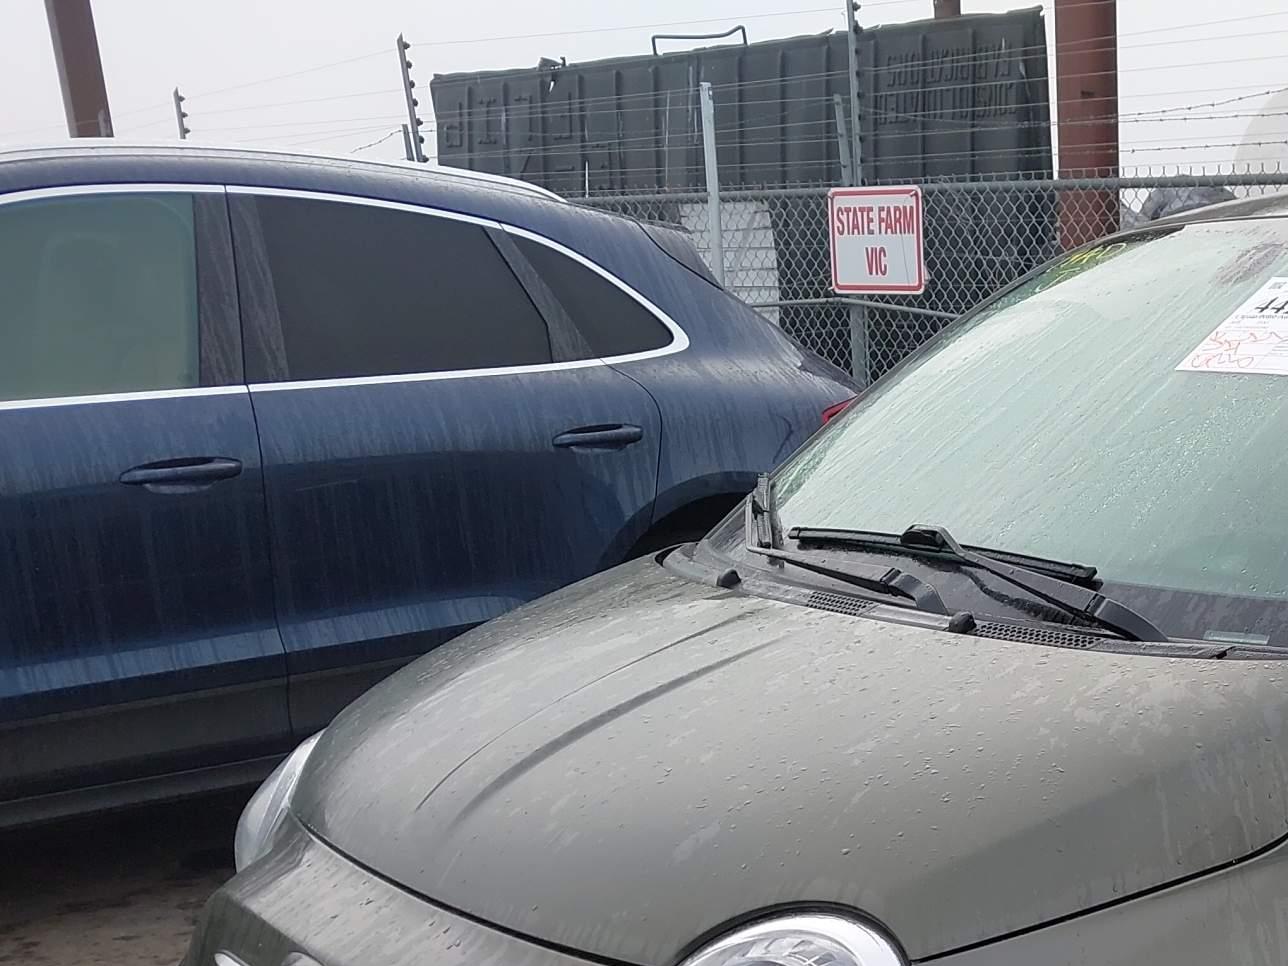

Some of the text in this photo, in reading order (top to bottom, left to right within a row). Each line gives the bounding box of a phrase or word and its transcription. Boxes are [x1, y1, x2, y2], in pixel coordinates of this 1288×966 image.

[836, 205, 915, 236] STATE FARM
[865, 246, 888, 276] VIC
